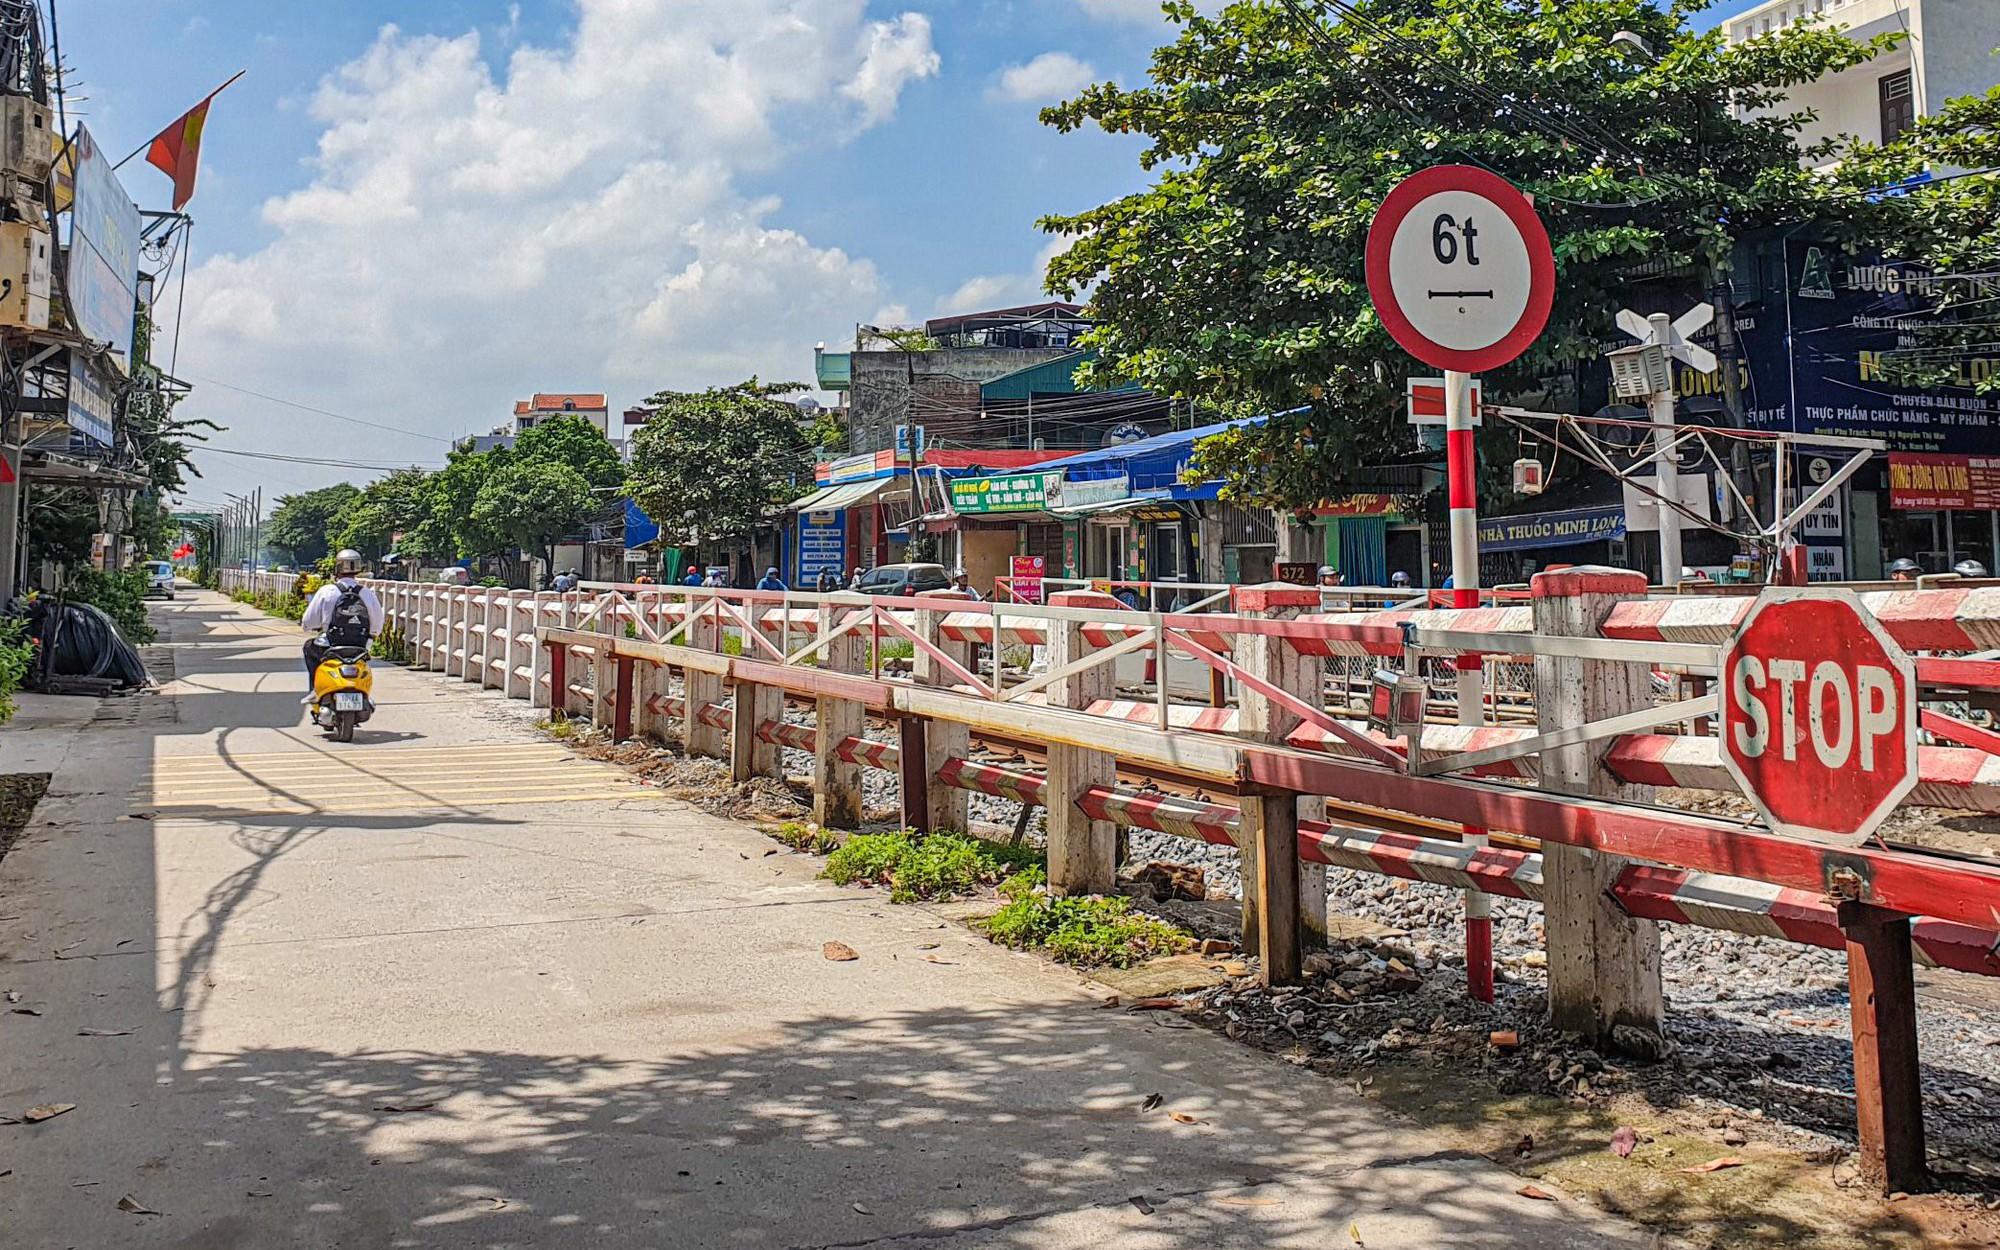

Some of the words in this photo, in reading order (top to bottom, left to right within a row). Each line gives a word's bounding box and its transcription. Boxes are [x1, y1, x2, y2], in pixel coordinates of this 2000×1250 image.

[1432, 213, 1480, 266] 6t
[1805, 406, 1834, 422] THỰC
[1837, 404, 1868, 421] PHẨM
[1871, 408, 1899, 423] CHỨC
[1902, 408, 1930, 424] NĂNG
[1478, 525, 1506, 543] NHÀ
[1506, 517, 1551, 539] THUỐC
[1553, 518, 1588, 536] MINH
[1805, 515, 1820, 529] UY
[1822, 511, 1839, 529] TÍN
[1813, 550, 1835, 570] NHẬN
[1282, 567, 1305, 580] 372
[1733, 655, 1898, 772] STOP
